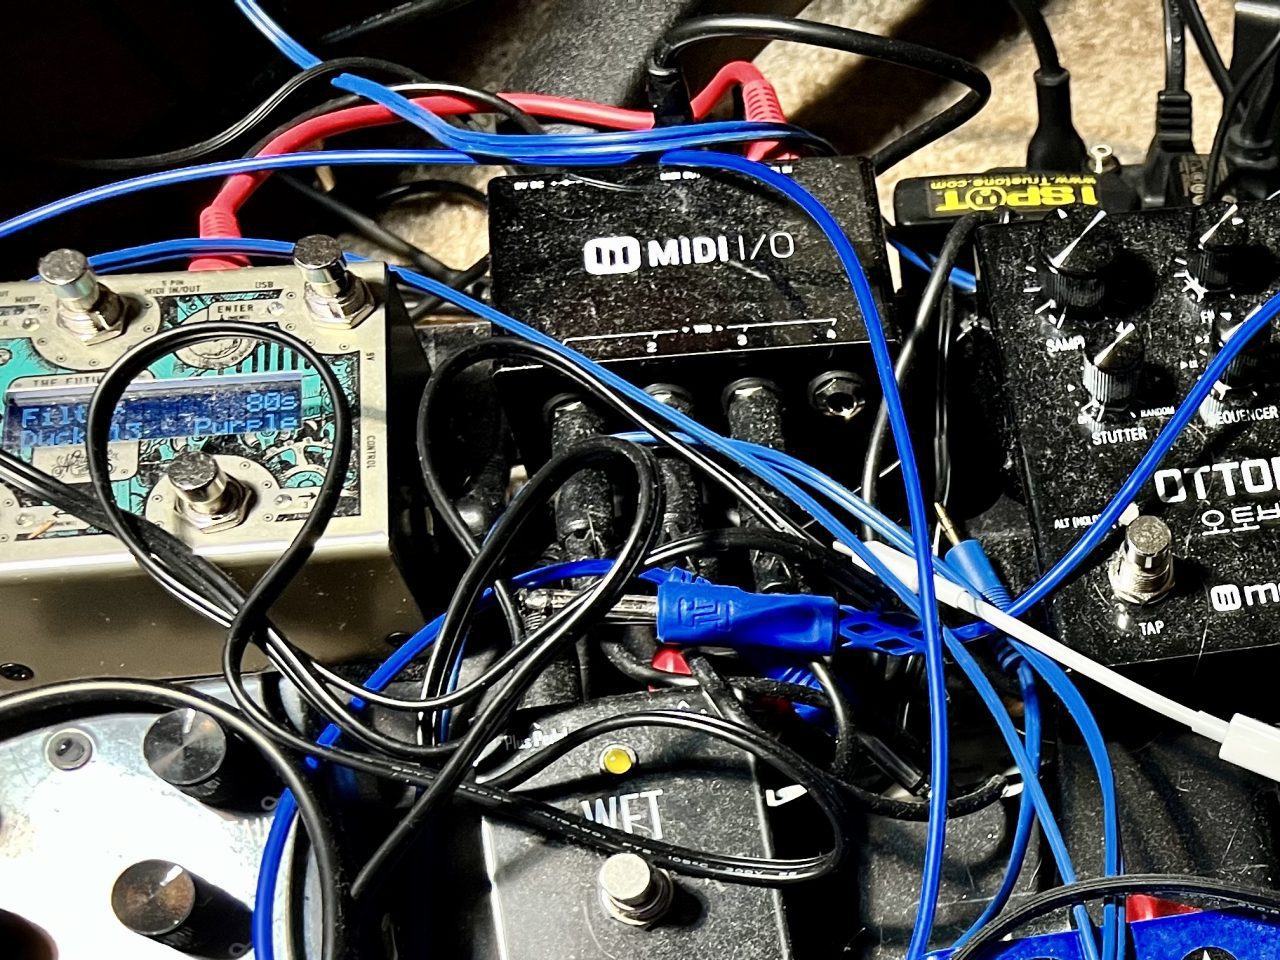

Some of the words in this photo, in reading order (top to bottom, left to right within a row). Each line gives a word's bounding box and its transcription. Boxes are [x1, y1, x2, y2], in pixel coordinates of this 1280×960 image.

[648, 236, 729, 267] MIDI
[737, 231, 795, 261] I/O
[255, 281, 274, 289] USB
[217, 304, 254, 314] ENTER
[1091, 427, 1148, 446] STUTTER
[365, 435, 376, 469] CONTROL
[1138, 620, 1165, 637] TAP
